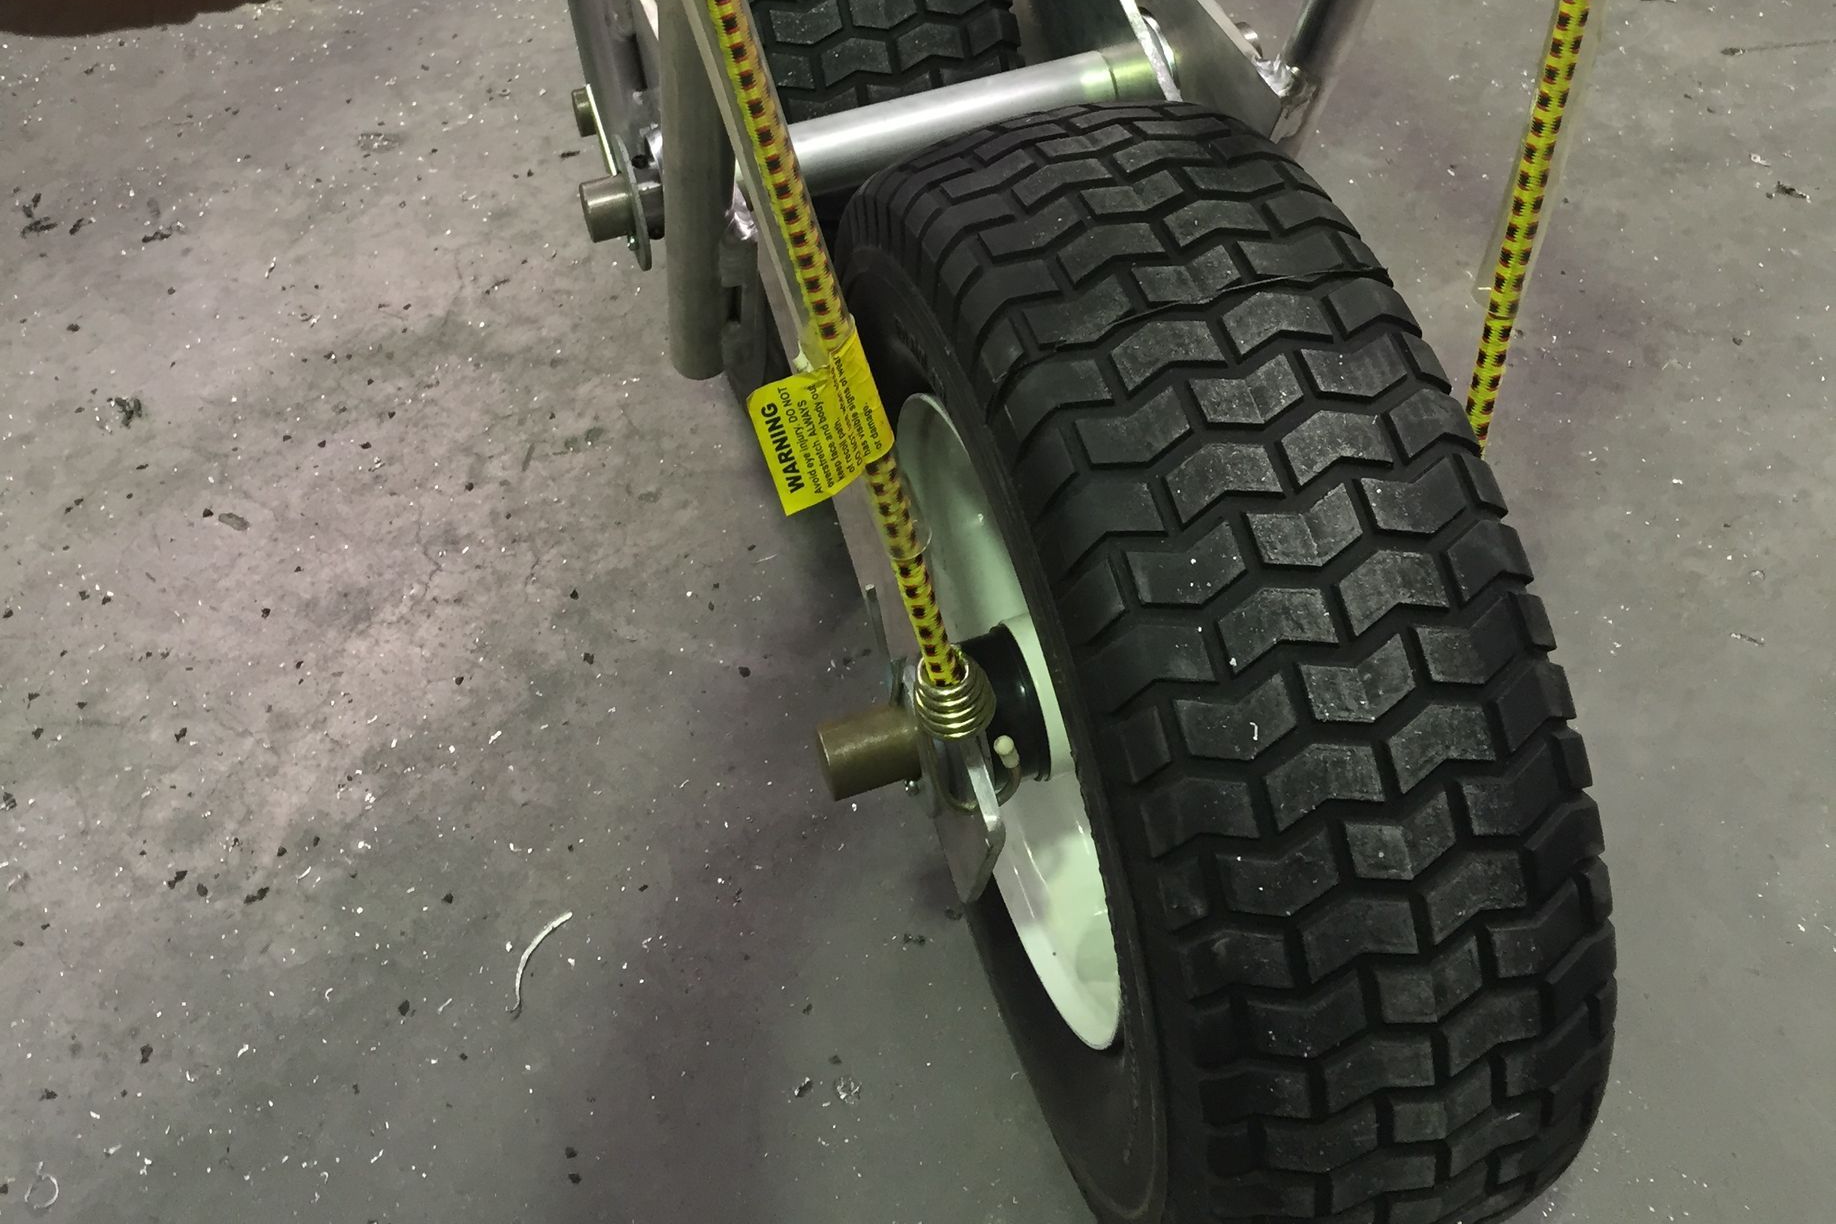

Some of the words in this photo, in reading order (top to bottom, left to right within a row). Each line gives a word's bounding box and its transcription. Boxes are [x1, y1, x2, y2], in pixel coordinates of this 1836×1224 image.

[778, 387, 792, 407] NOT
[842, 388, 857, 411] signs
[786, 409, 798, 423] DO
[797, 400, 818, 437] ALWAYS
[813, 401, 827, 424] body
[821, 425, 832, 441] and
[850, 413, 865, 439] visible
[760, 403, 806, 493] WARNING
[826, 443, 839, 460] face
[803, 453, 816, 468] eye
[833, 461, 845, 481] keep
[808, 471, 823, 494] Avoid
